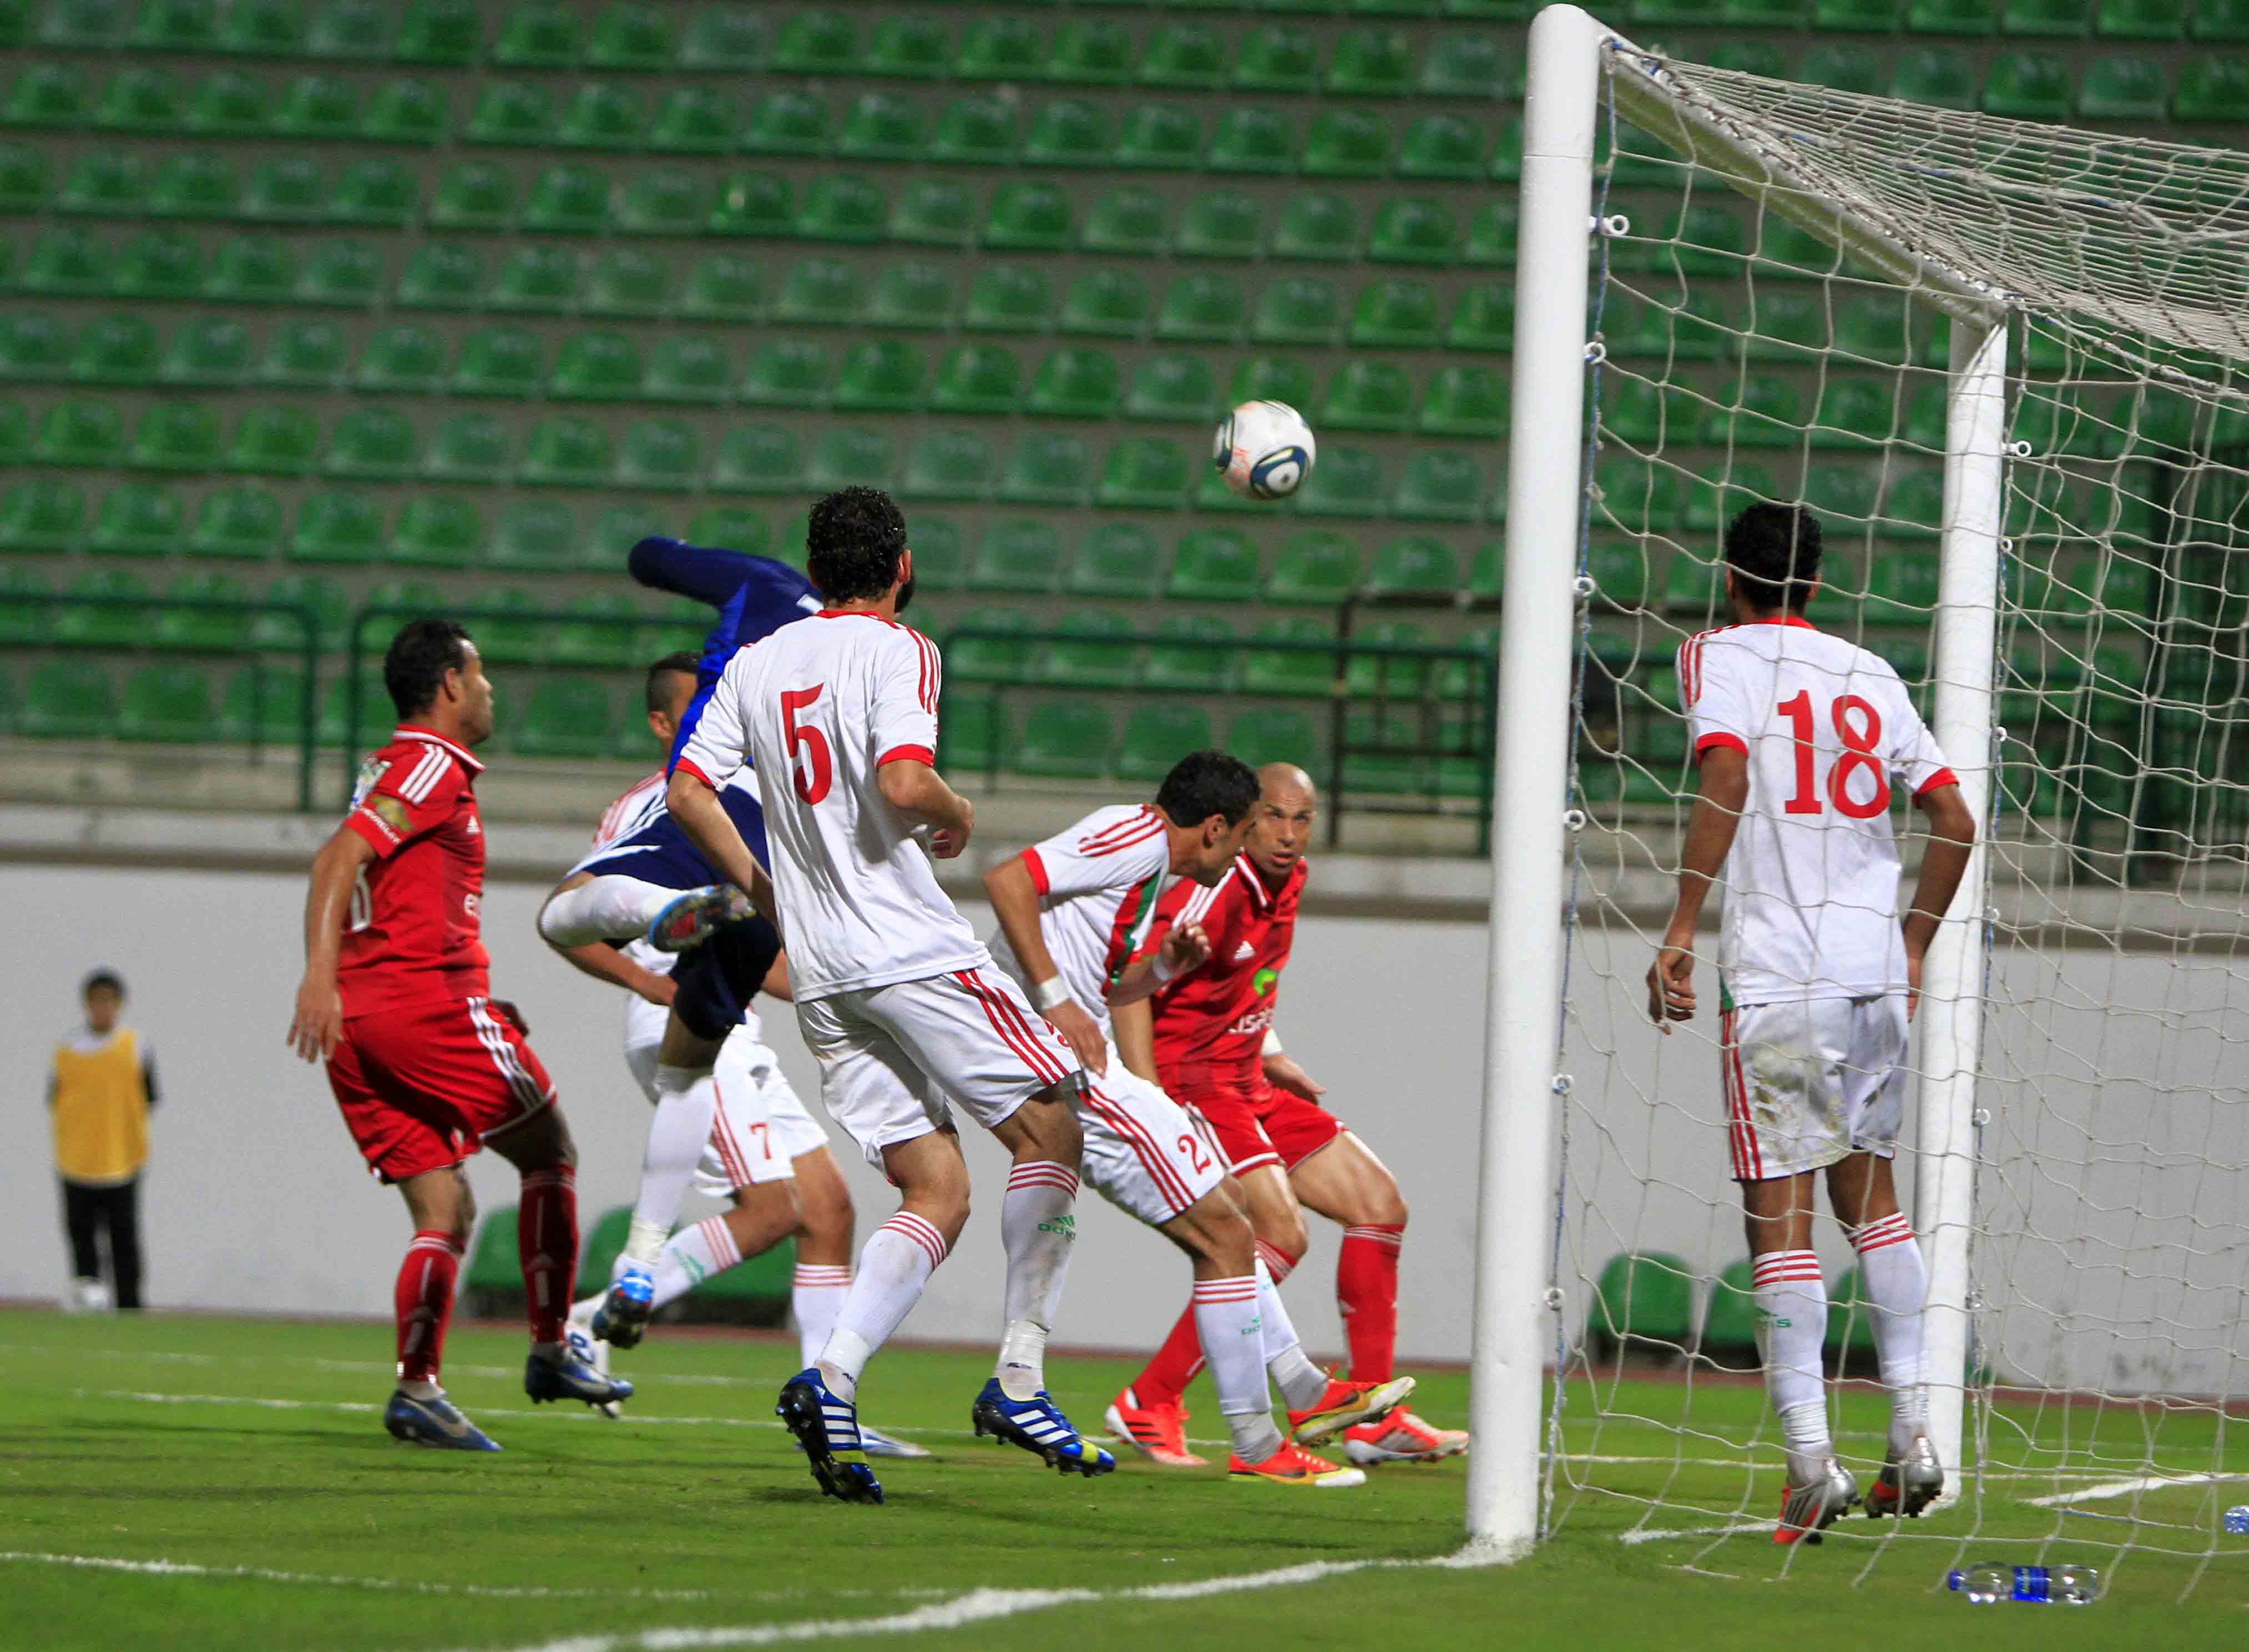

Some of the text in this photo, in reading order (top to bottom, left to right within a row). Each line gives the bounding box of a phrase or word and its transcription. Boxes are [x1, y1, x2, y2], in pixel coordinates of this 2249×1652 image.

[781, 683, 832, 805] 5
[1777, 689, 1891, 819] 18
[749, 1121, 771, 1160] 7
[1177, 1134, 1211, 1174] 2
